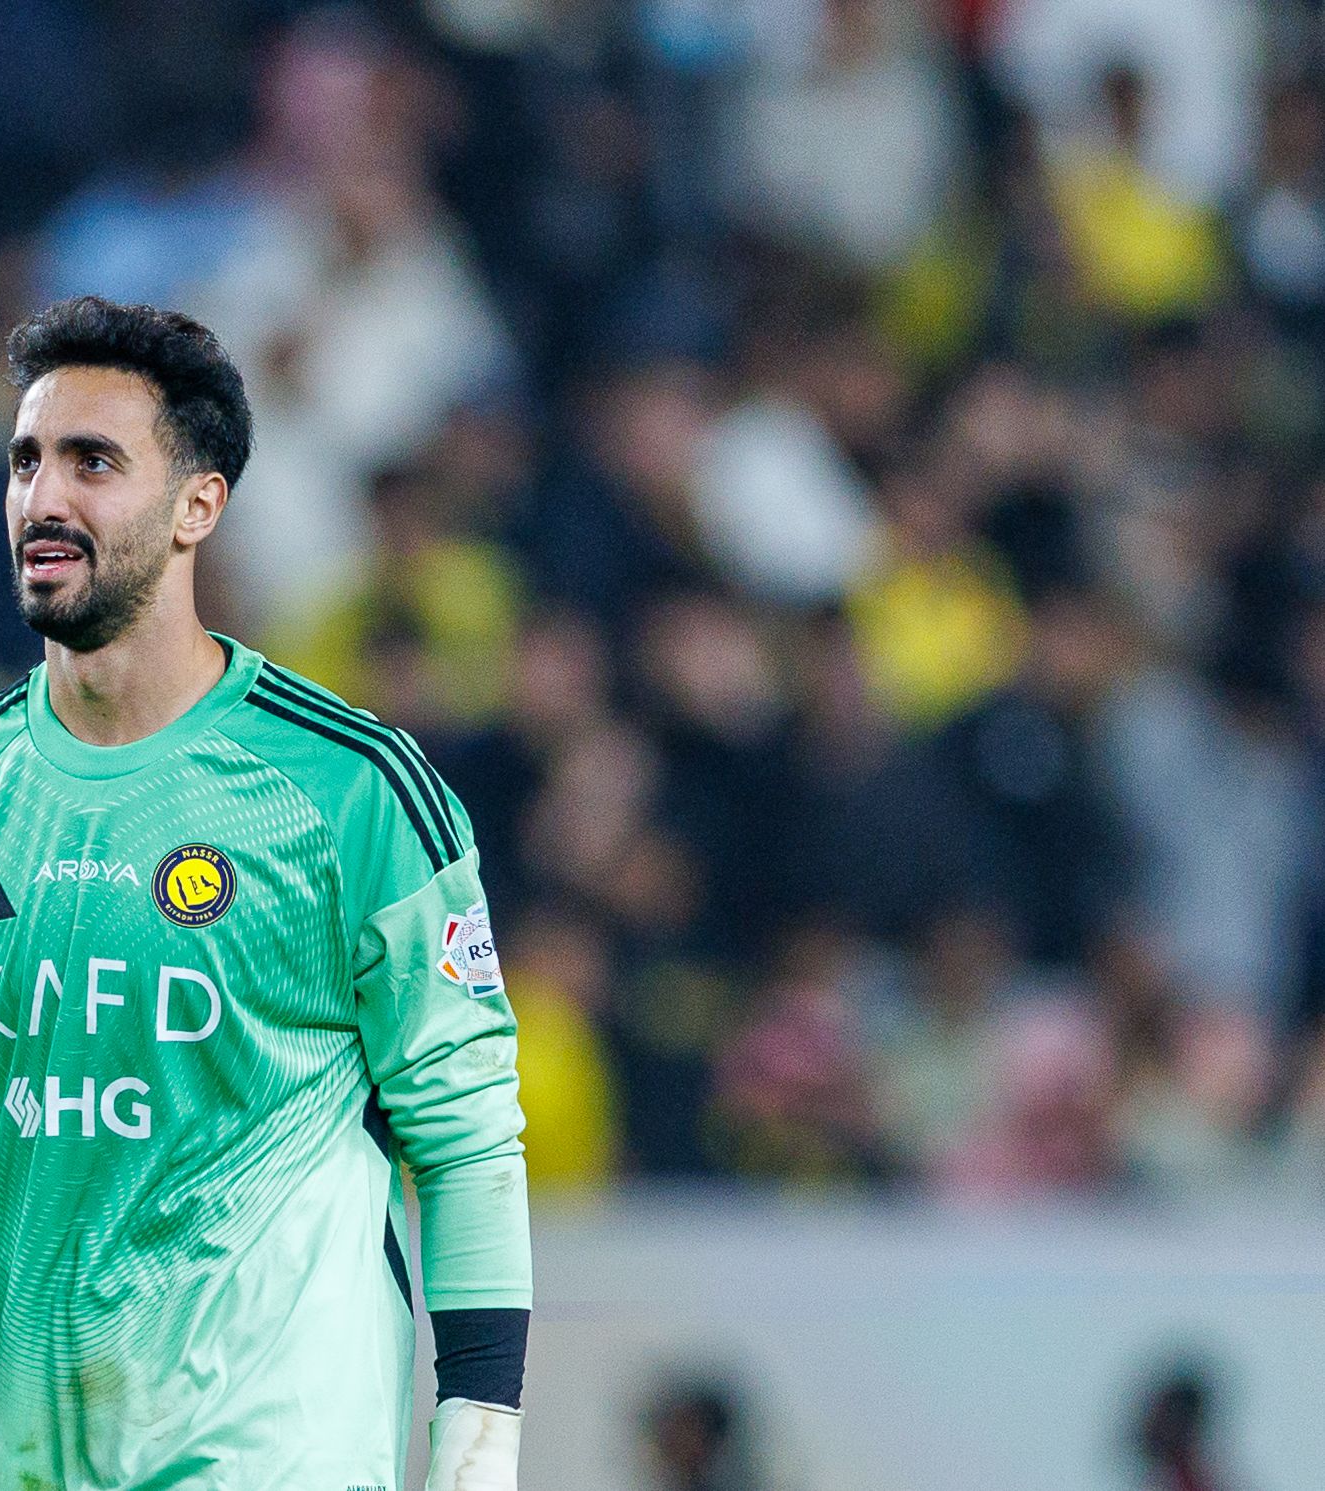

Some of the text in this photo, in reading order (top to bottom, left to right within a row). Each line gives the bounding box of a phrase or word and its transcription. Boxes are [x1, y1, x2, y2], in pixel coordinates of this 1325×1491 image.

[181, 848, 219, 864] NASSR
[32, 858, 140, 887] AROYA
[44, 1075, 152, 1140] HG
